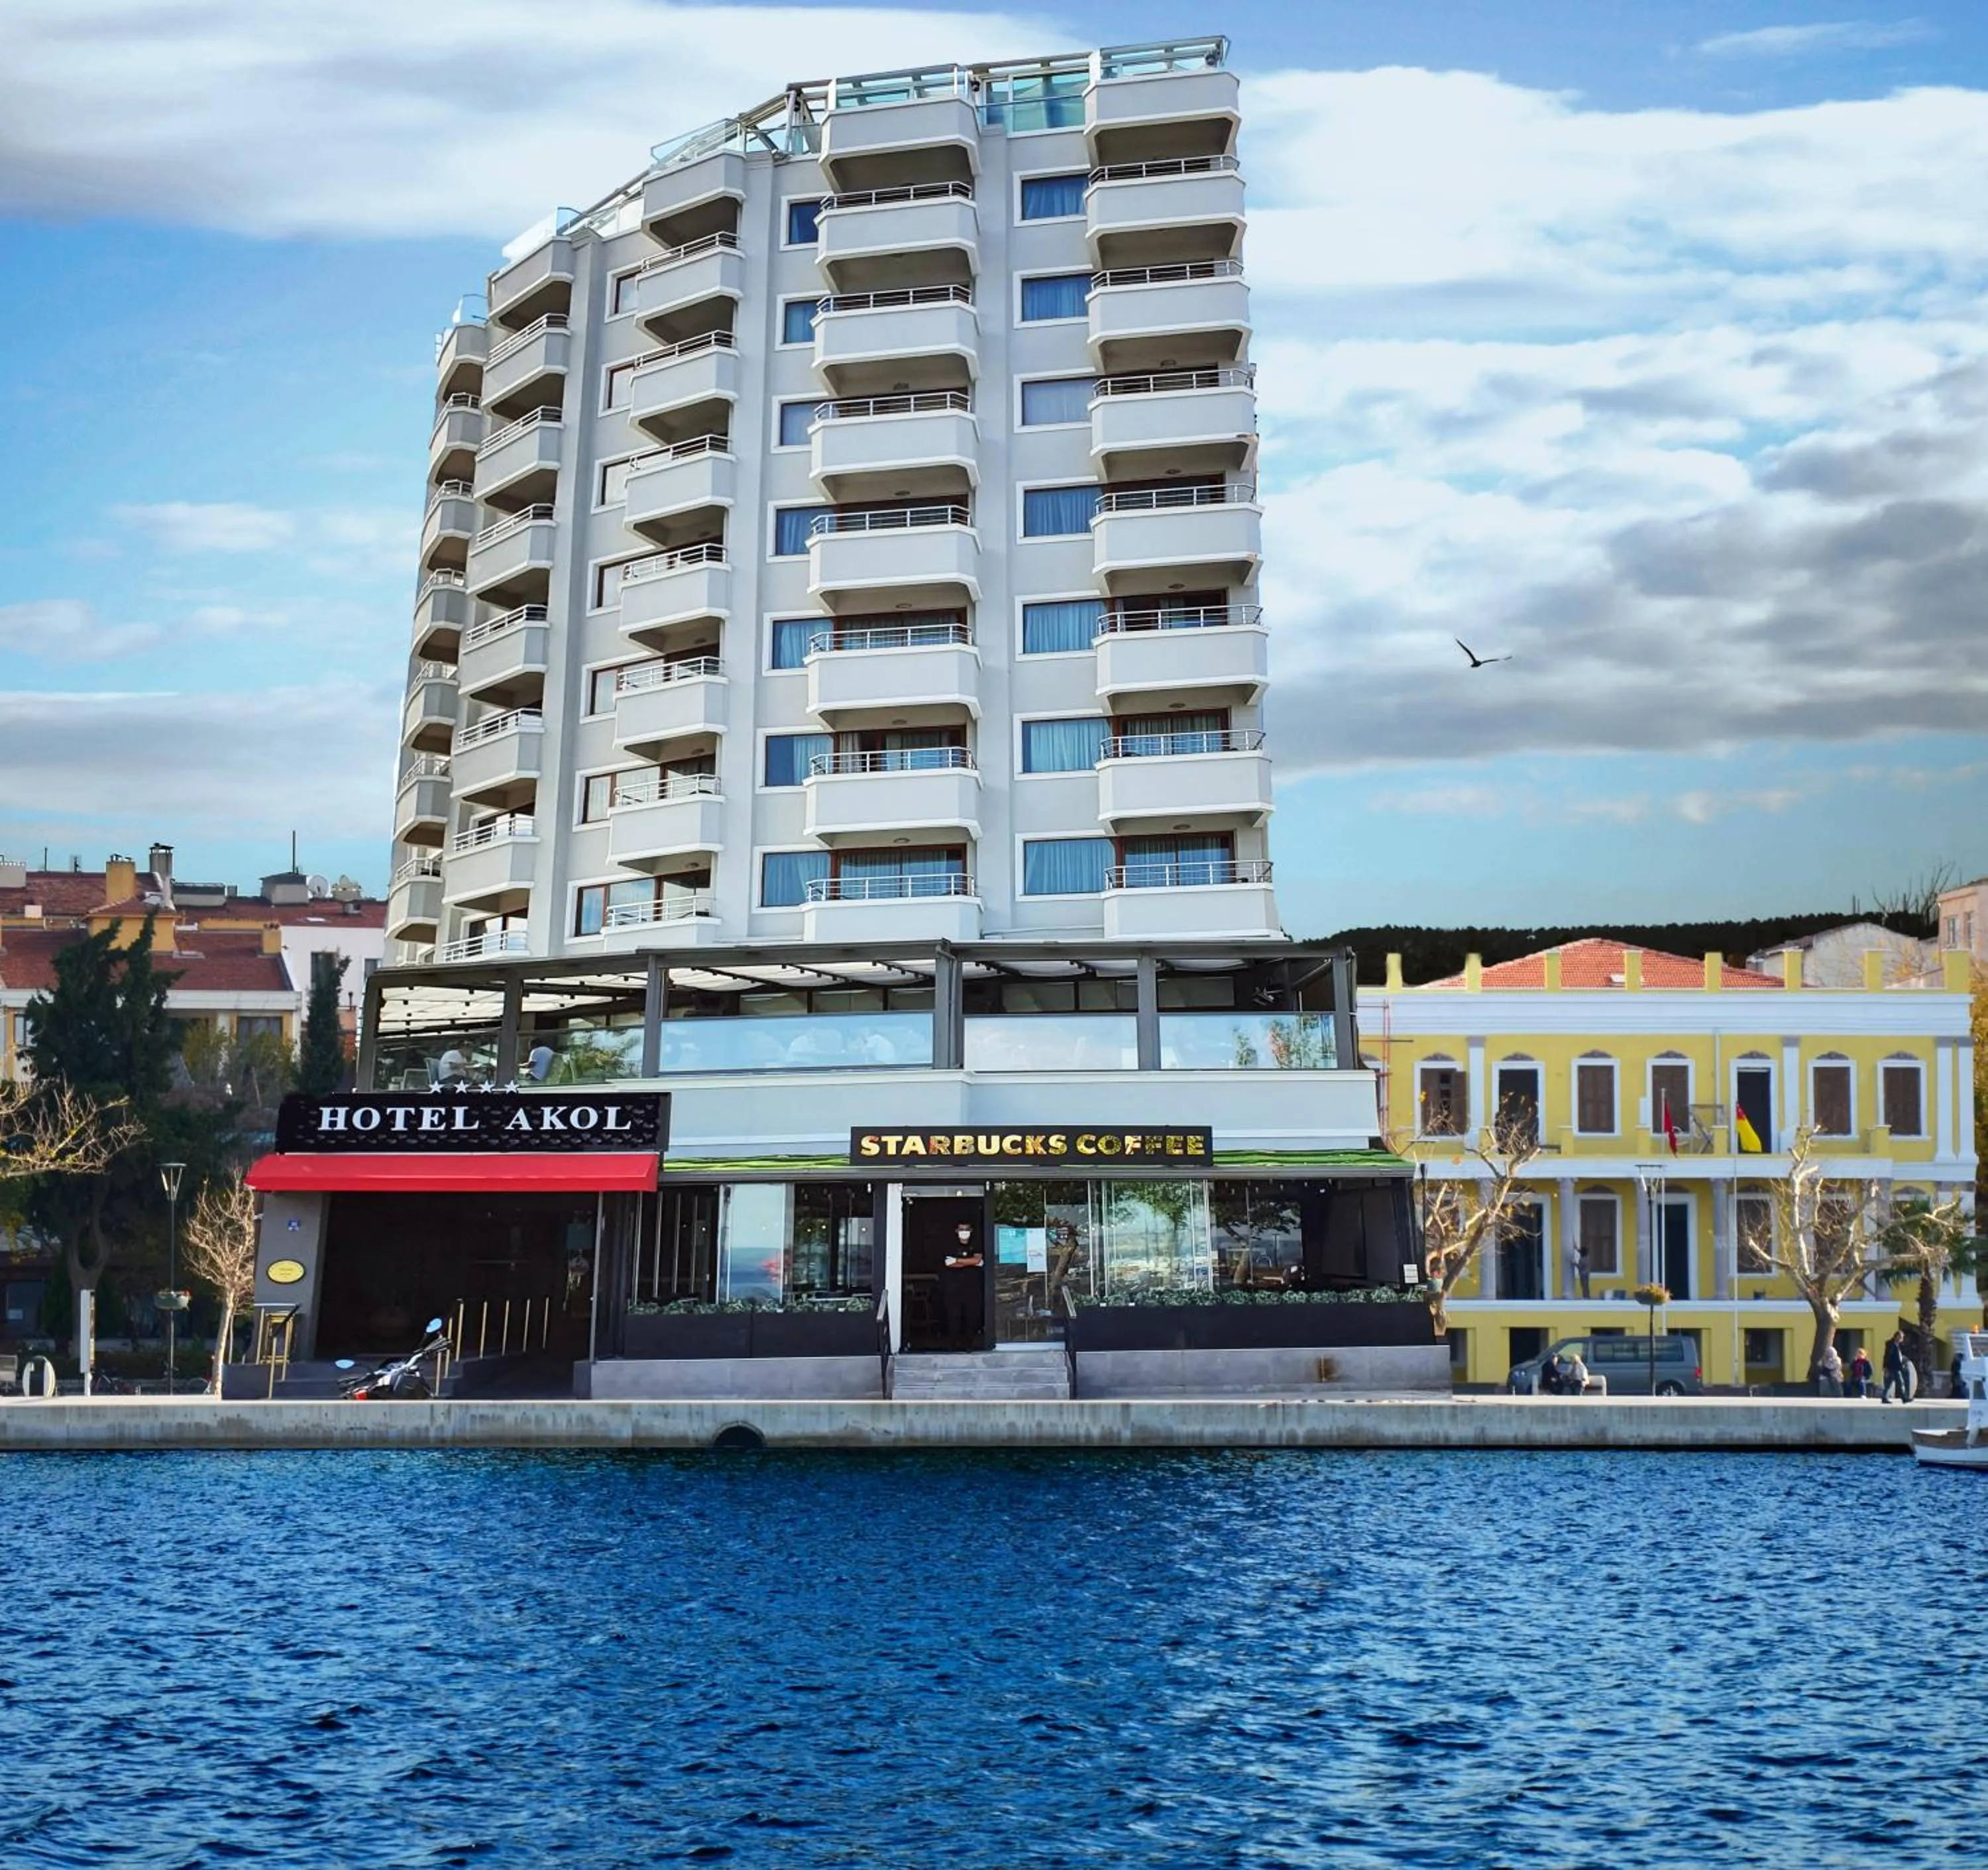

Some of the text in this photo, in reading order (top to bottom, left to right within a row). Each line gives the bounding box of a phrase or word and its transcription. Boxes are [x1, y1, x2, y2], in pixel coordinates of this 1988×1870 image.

[317, 1106, 632, 1130] HOTEL AKOL
[860, 1134, 1205, 1156] STARBUCKS COFFEE
